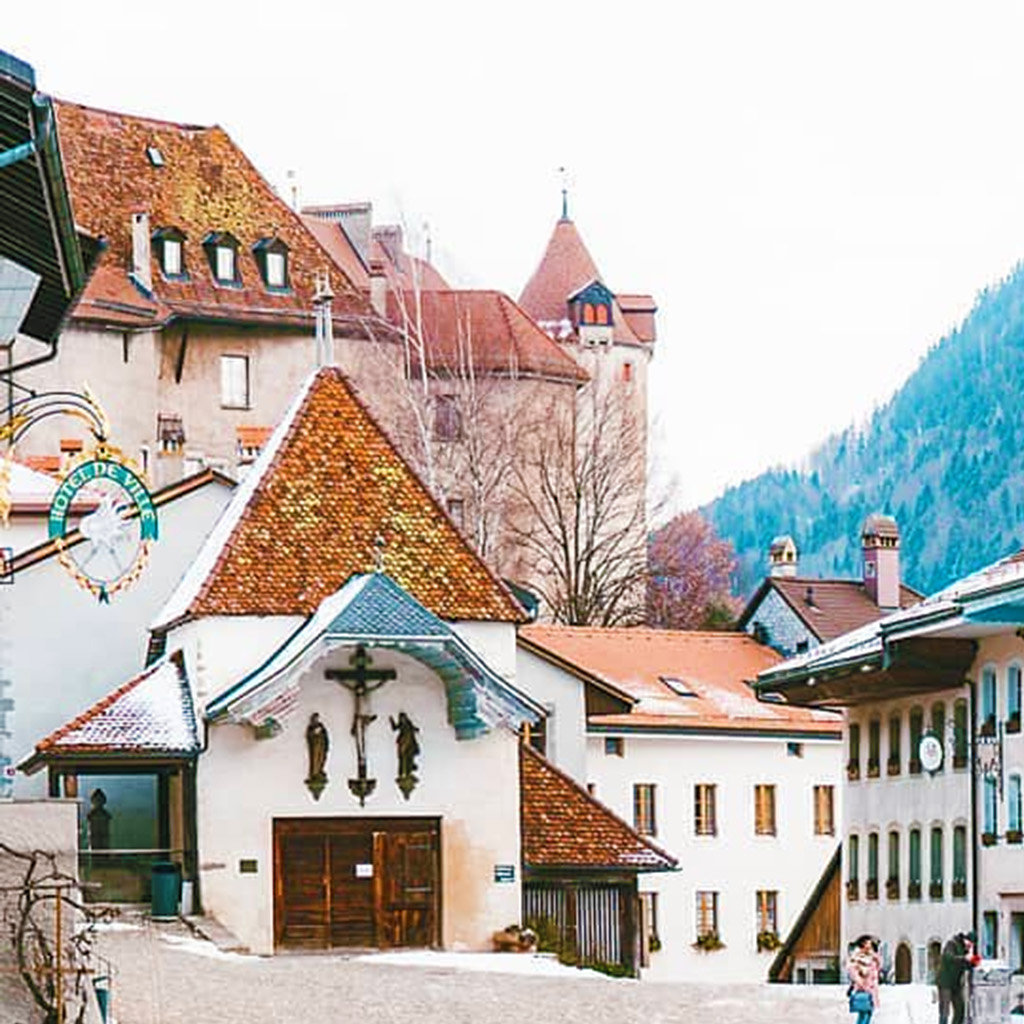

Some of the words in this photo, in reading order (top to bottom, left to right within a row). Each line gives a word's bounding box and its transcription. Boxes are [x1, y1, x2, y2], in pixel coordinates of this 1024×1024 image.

[50, 465, 94, 521] HOTEL
[94, 462, 121, 478] DE
[123, 474, 156, 521] VILLE
